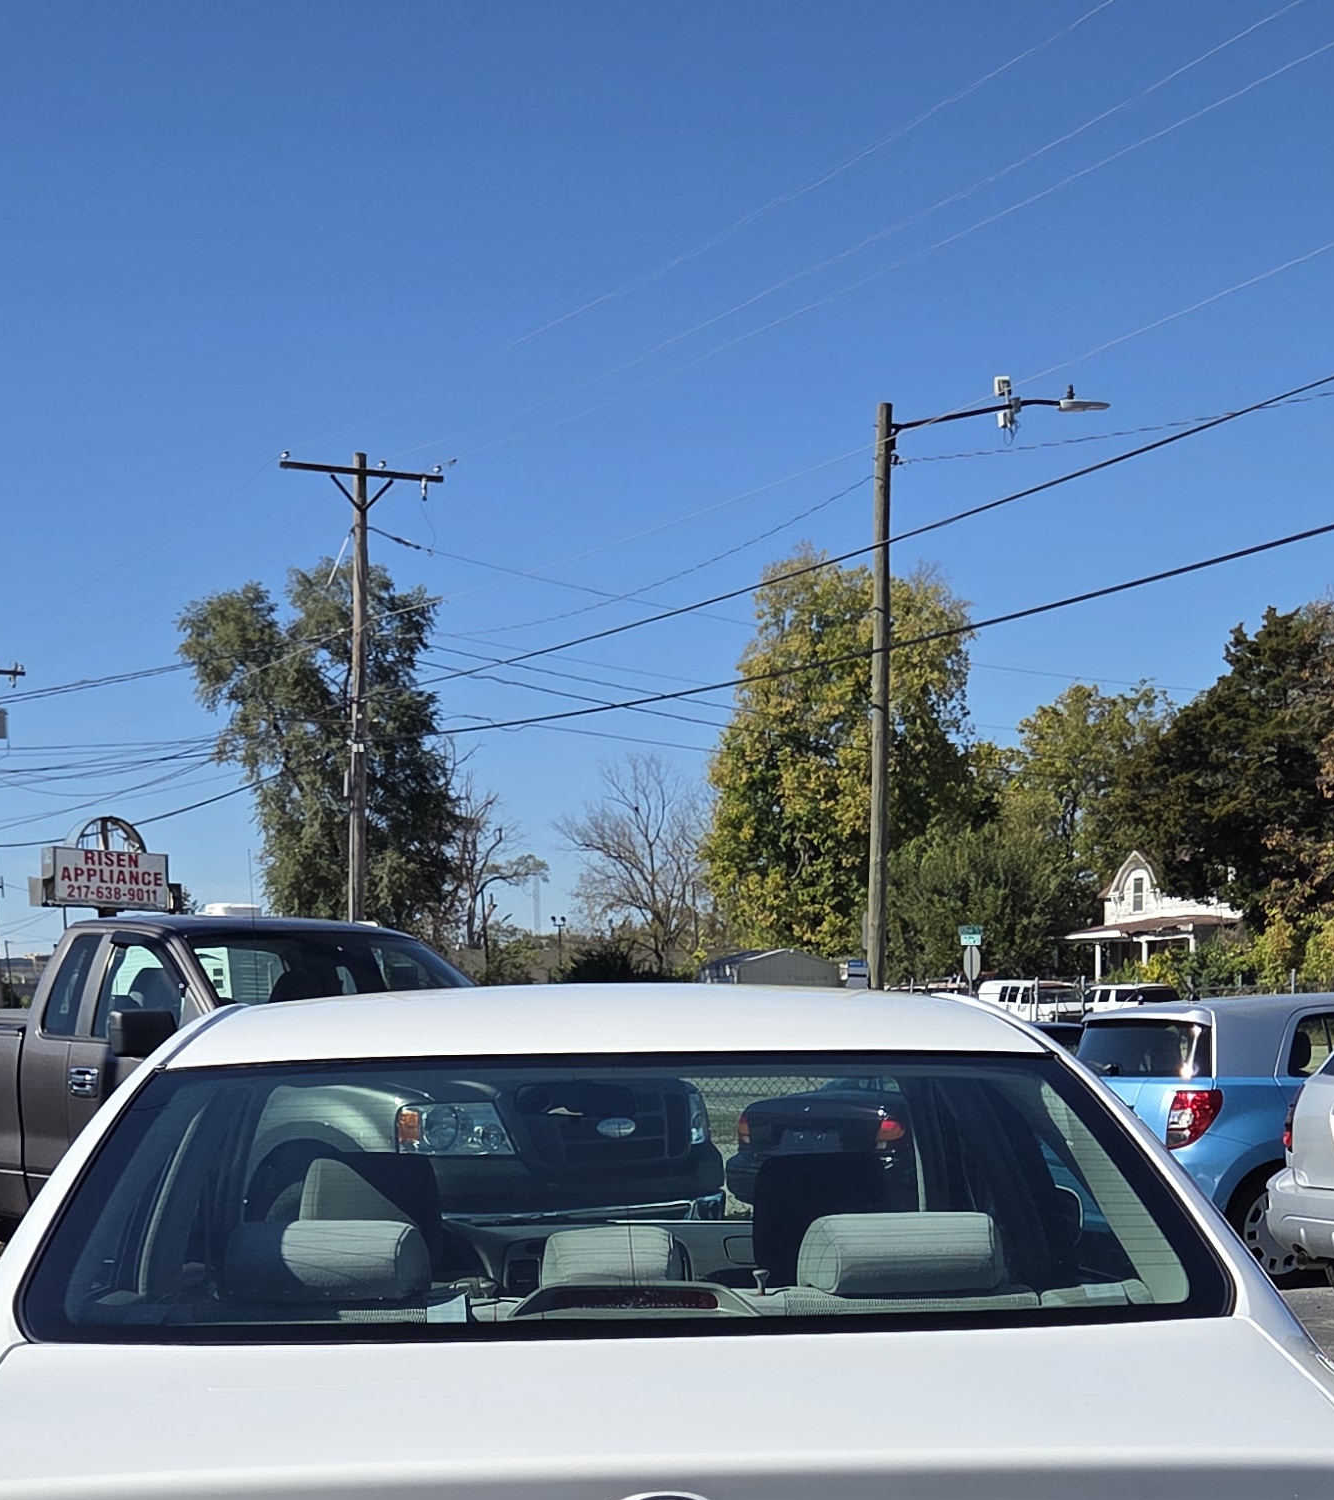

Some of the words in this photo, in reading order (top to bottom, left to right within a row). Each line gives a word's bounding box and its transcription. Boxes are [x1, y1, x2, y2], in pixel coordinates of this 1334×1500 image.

[83, 850, 140, 869] RISEN
[60, 867, 163, 888] APPLIANCE
[67, 884, 158, 902] 217-638-9011
